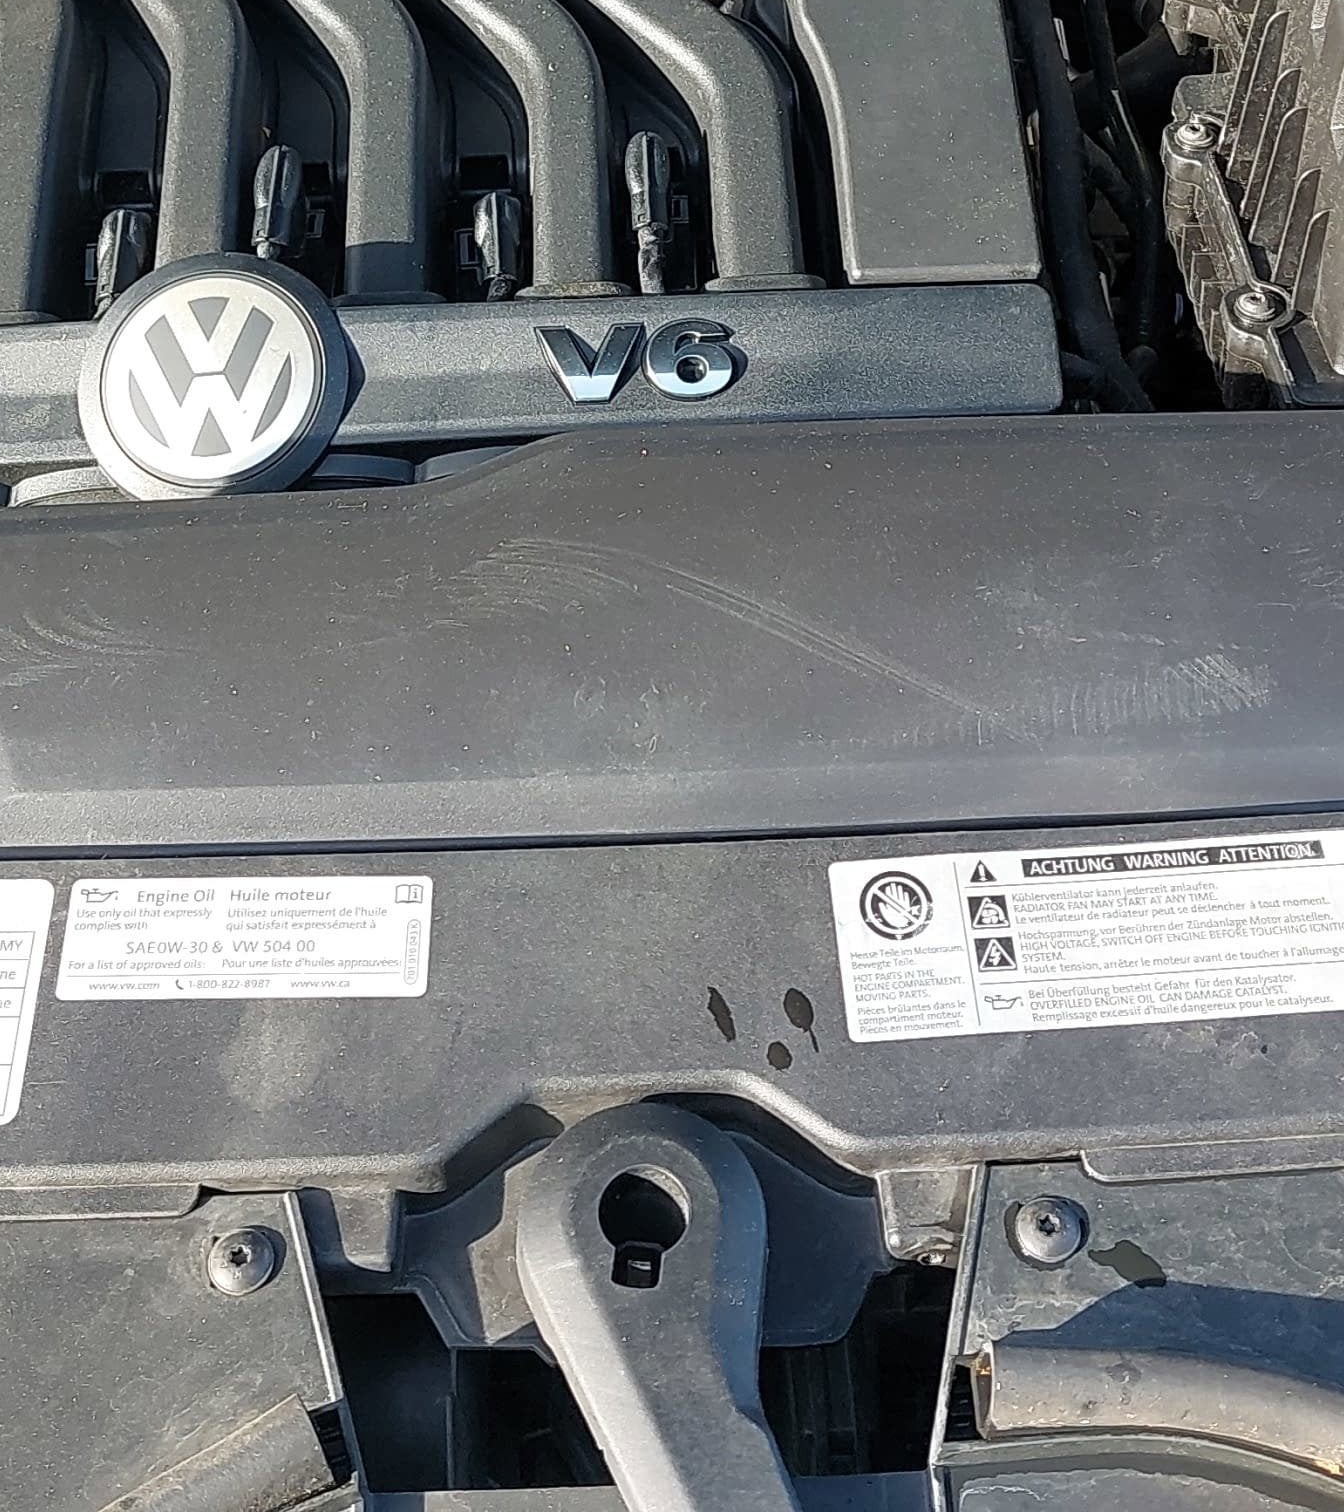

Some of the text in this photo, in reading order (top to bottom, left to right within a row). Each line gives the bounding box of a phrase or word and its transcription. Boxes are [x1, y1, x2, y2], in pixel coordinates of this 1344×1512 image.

[533, 317, 738, 405] V6
[1030, 856, 1115, 875] ACHTUNG
[1124, 849, 1209, 869] WARNING
[137, 889, 215, 906] Engine Oil
[230, 888, 331, 902] Huile moteur
[1014, 891, 1218, 913] RADIATOR FAN MAY START AT ANY TIME.
[76, 907, 212, 920] Use only oil that expressly
[227, 905, 388, 919] Utilisez uniquement de l'huile
[74, 920, 148, 933] complies with
[225, 919, 376, 932] qui satisfait expressément à
[1020, 941, 1048, 952] HIGH
[1102, 935, 1143, 947] SWITCH
[1145, 934, 1163, 944] OFF
[1167, 930, 1206, 942] ENGINE
[1209, 926, 1249, 938] BEFORE
[1251, 923, 1307, 936] TOUCHING
[0, 940, 23, 951] MY
[211, 942, 224, 954] &
[232, 940, 259, 953] VW
[263, 940, 292, 953] 504
[296, 939, 316, 952] 00
[222, 958, 246, 968] Pour
[249, 960, 268, 968] une
[270, 958, 292, 967] liste
[295, 957, 336, 967] d'huiles
[1022, 952, 1065, 963] SYSTEM.
[68, 960, 86, 970] For
[88, 962, 94, 970] a
[97, 960, 113, 970] list
[116, 959, 129, 970] of
[130, 959, 181, 973] approved
[188, 979, 271, 989] 1-800-822-8987
[1030, 985, 1288, 1011] OVERFILLED ENGINE OIL CAN DAMAGE CATALYST.
